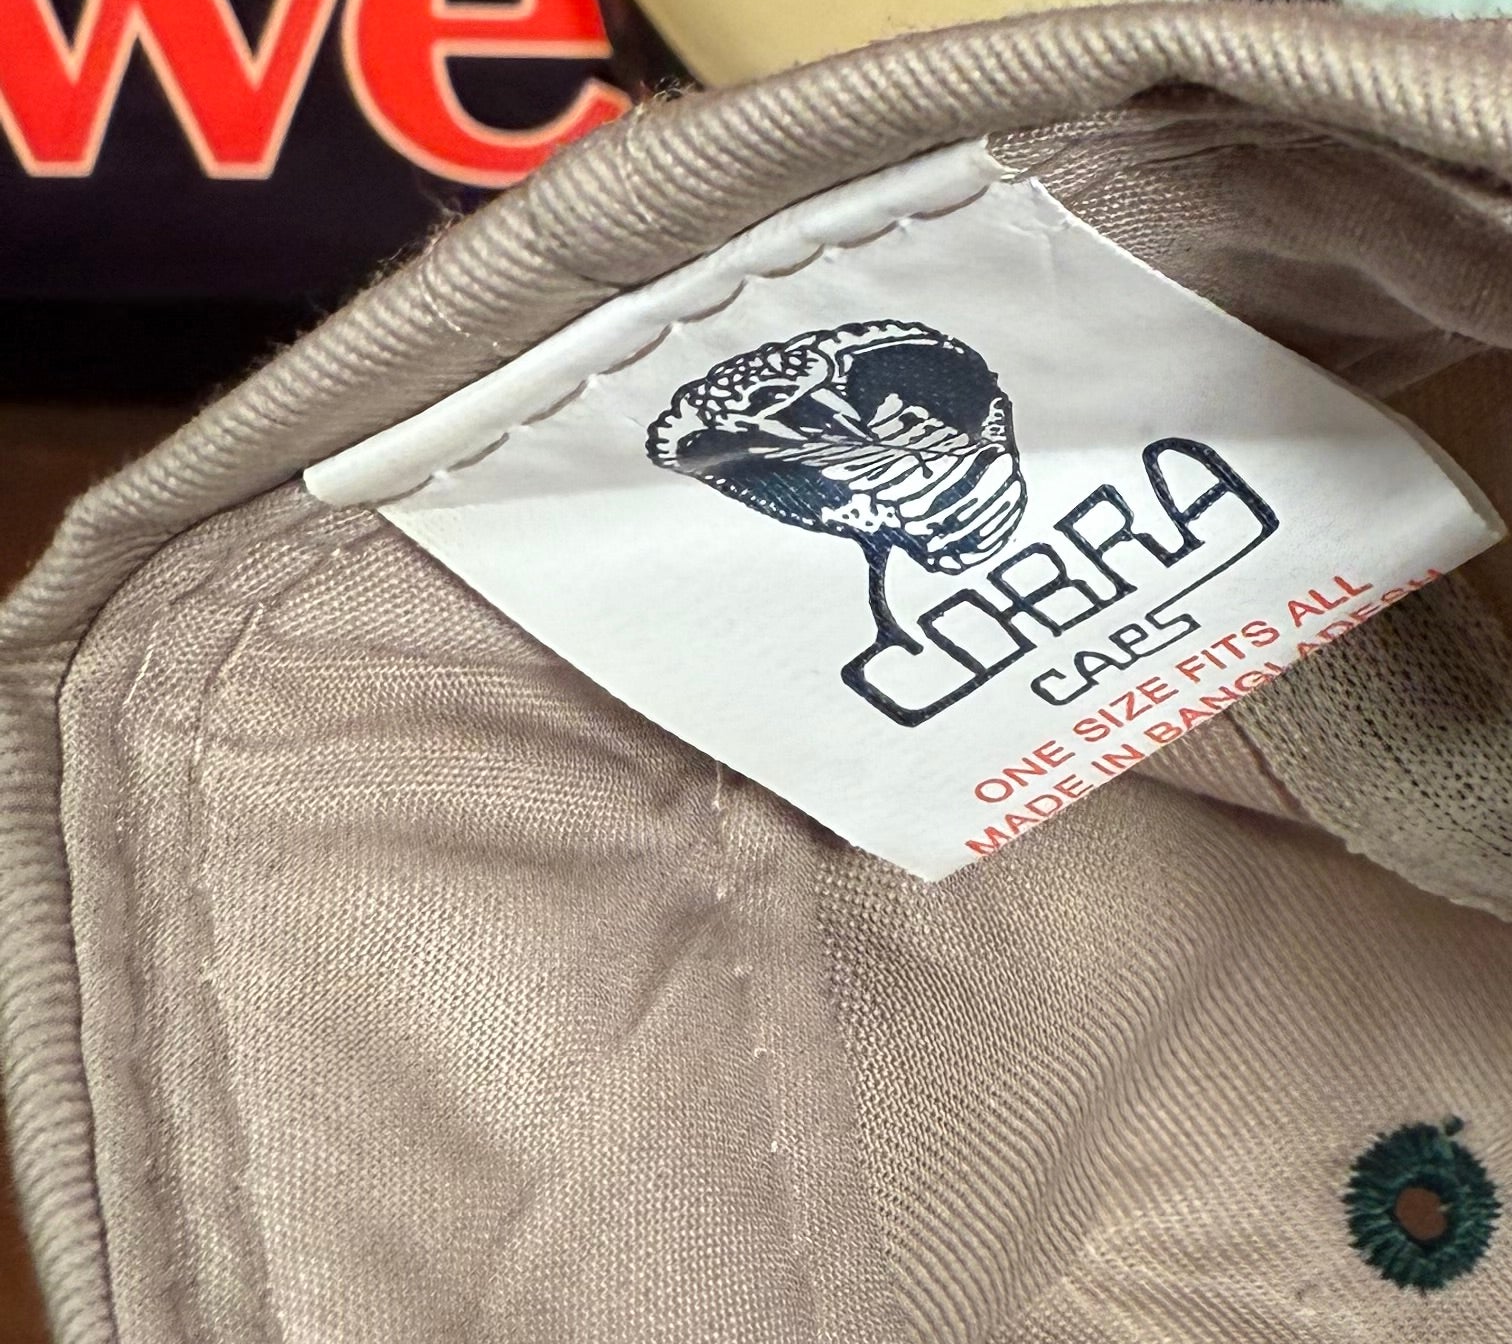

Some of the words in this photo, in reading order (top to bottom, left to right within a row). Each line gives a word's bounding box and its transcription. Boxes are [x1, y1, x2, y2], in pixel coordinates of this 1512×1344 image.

[841, 437, 1280, 728] COBRA
[974, 740, 1076, 803] ONE
[1072, 676, 1179, 742] SIZE
[1175, 620, 1280, 683] FITS
[1287, 575, 1373, 628] ALL
[1030, 612, 1202, 706] CAPS
[965, 774, 1094, 856] MADE
[1091, 743, 1146, 775] IN
[1143, 568, 1443, 744] BANGADES
